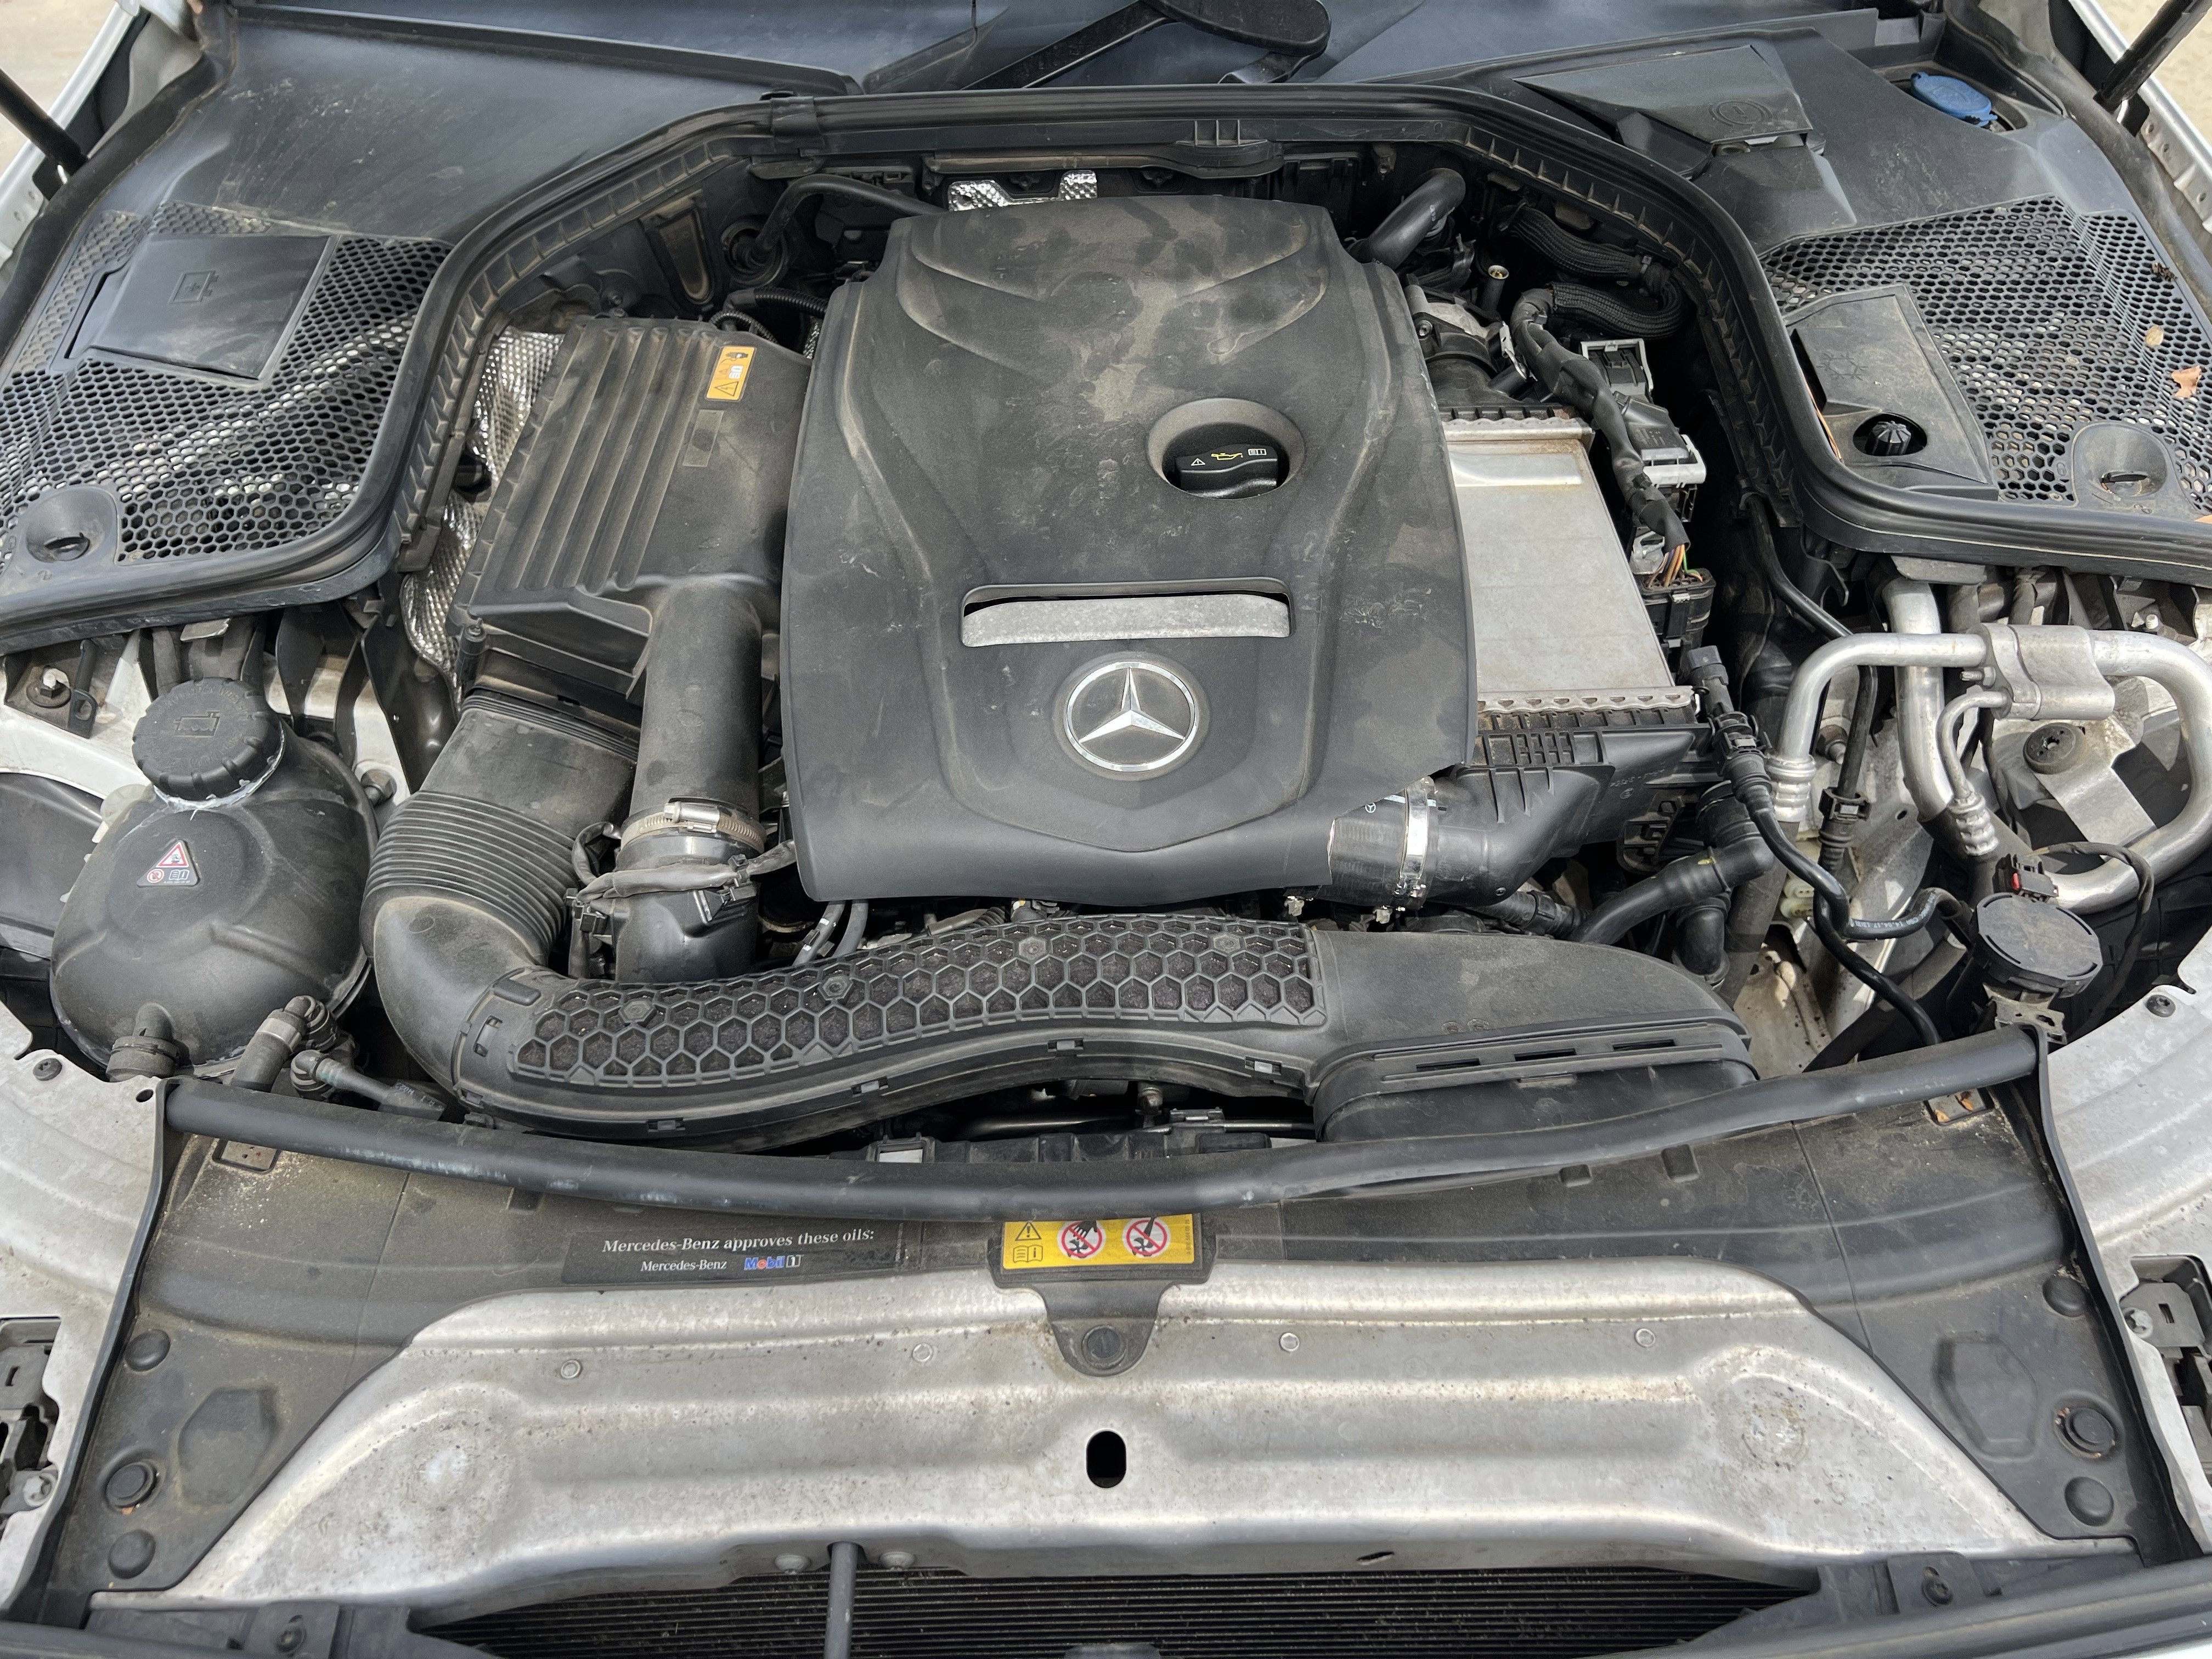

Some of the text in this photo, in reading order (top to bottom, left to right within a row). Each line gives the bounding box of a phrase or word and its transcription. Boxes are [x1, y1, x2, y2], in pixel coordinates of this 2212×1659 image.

[602, 1228, 874, 1252] Mercedes-Benz approves these oils:
[640, 1259, 727, 1272] Mercedes-Benz
[743, 1255, 786, 1271] Mobil
